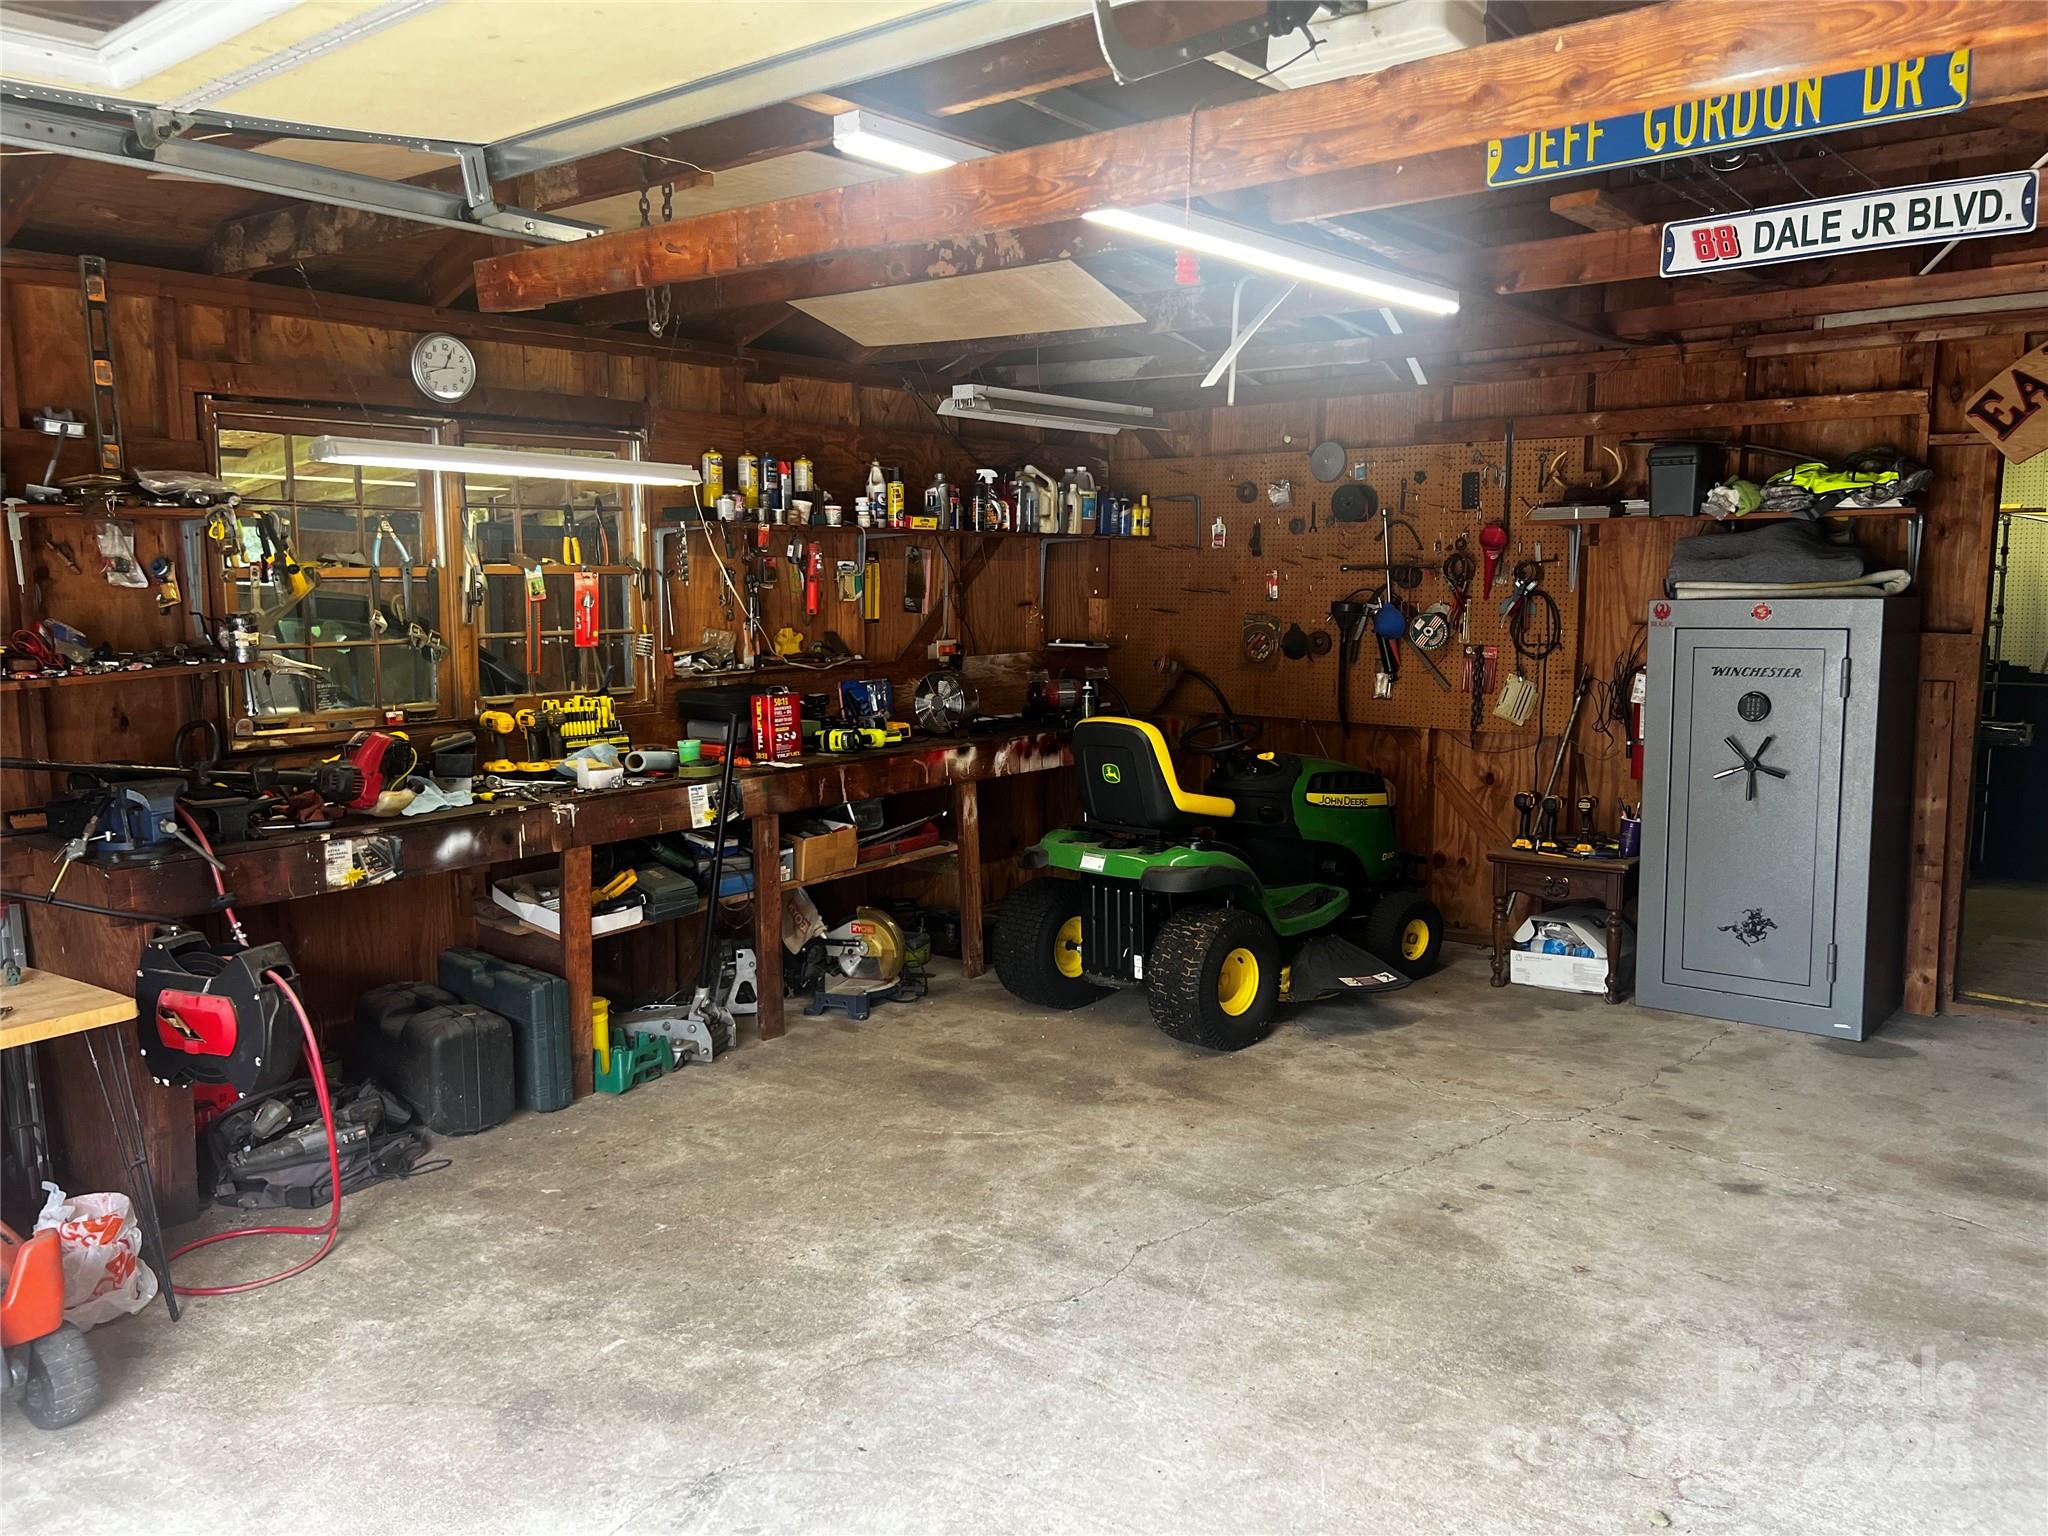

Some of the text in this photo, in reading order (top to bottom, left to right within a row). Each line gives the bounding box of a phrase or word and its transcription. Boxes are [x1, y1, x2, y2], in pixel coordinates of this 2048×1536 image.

[1514, 57, 1925, 174] JEFF GORDON DR
[1691, 189, 2012, 262] 88 DALE JR BLVD.
[1966, 342, 2048, 442] EA
[1712, 666, 1802, 678] WINCHESTER
[756, 698, 764, 751] TRUFUEL
[1319, 795, 1369, 806] JOHN DEERE
